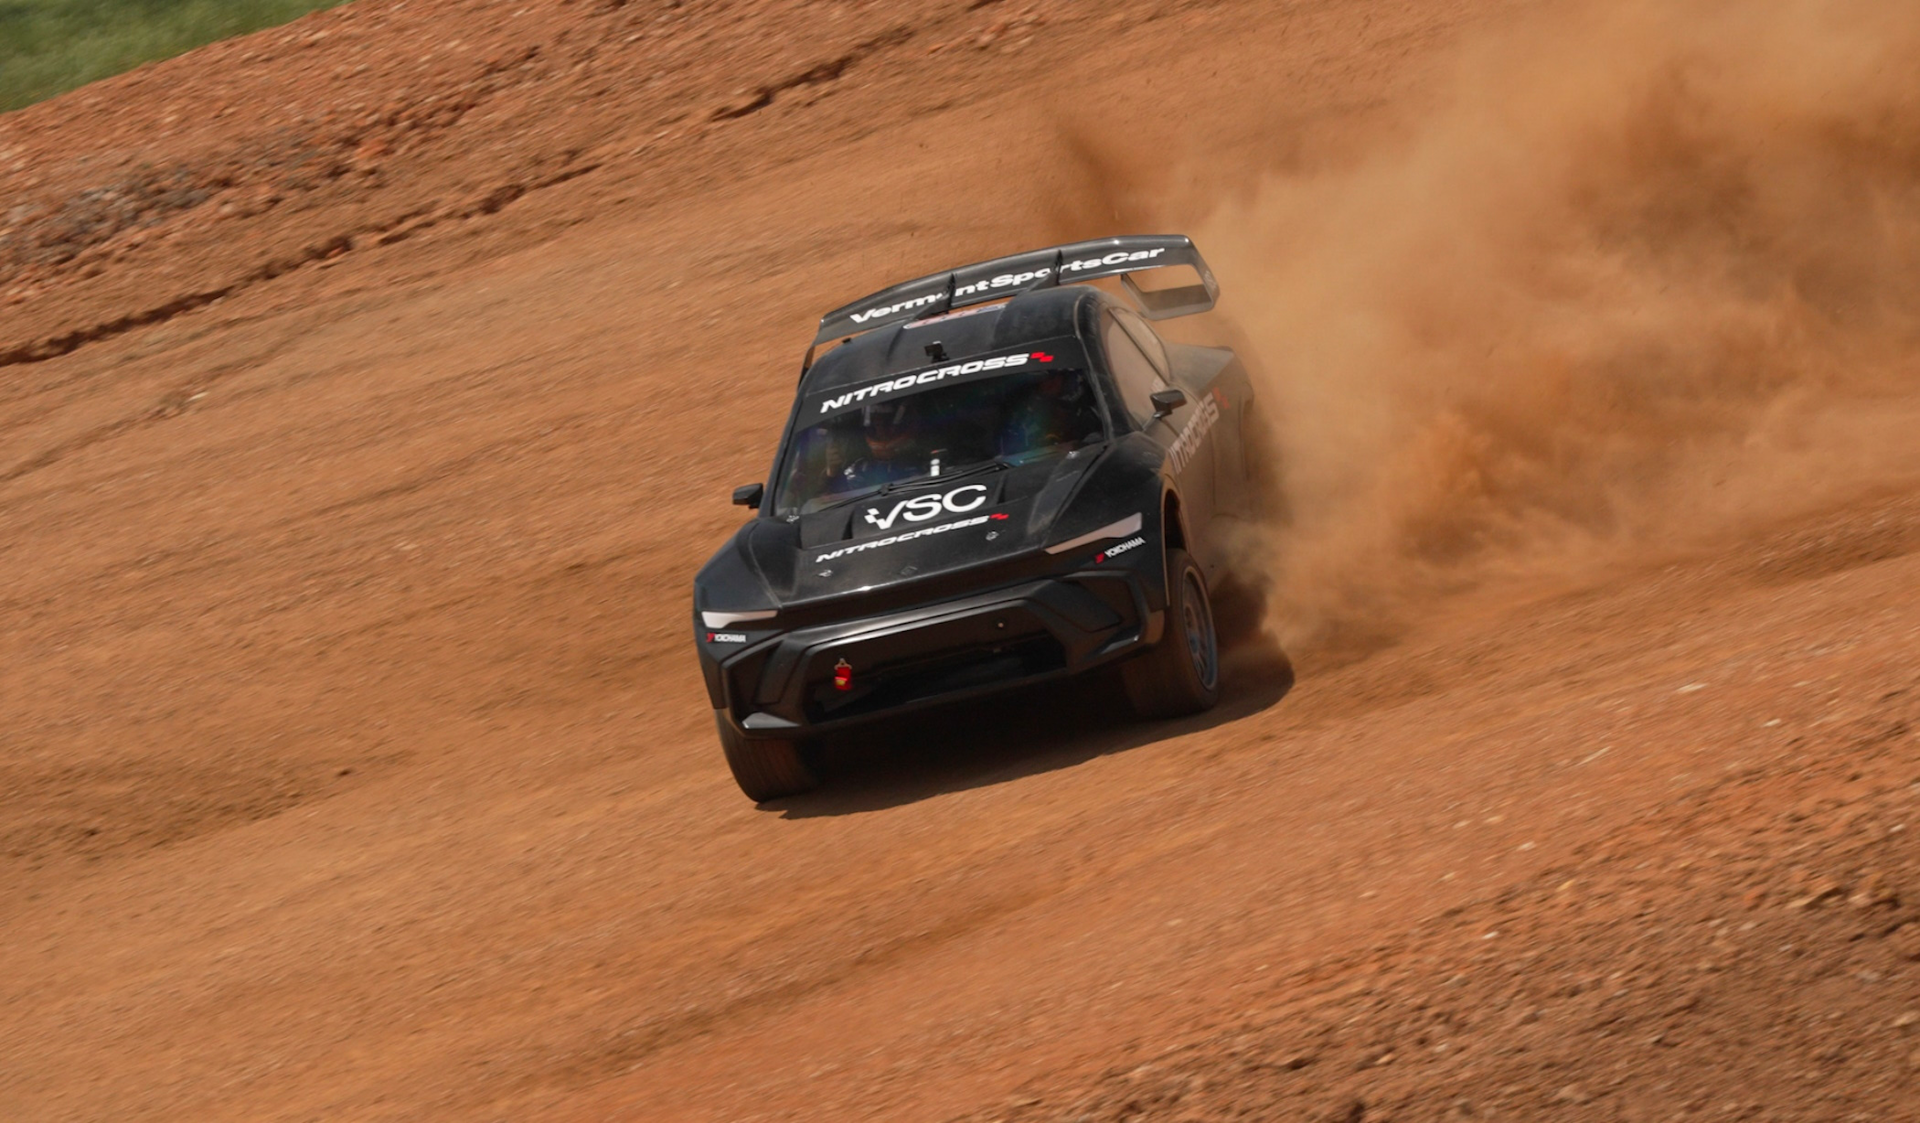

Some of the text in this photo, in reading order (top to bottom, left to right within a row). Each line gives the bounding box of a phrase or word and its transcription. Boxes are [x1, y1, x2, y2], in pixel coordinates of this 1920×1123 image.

[850, 248, 1165, 323] VermntSportsCar
[820, 353, 1029, 413] NITROCROSS
[864, 484, 987, 530] VSC
[815, 515, 990, 563] NITROCROSS
[1104, 536, 1146, 558] YOKOHAMA
